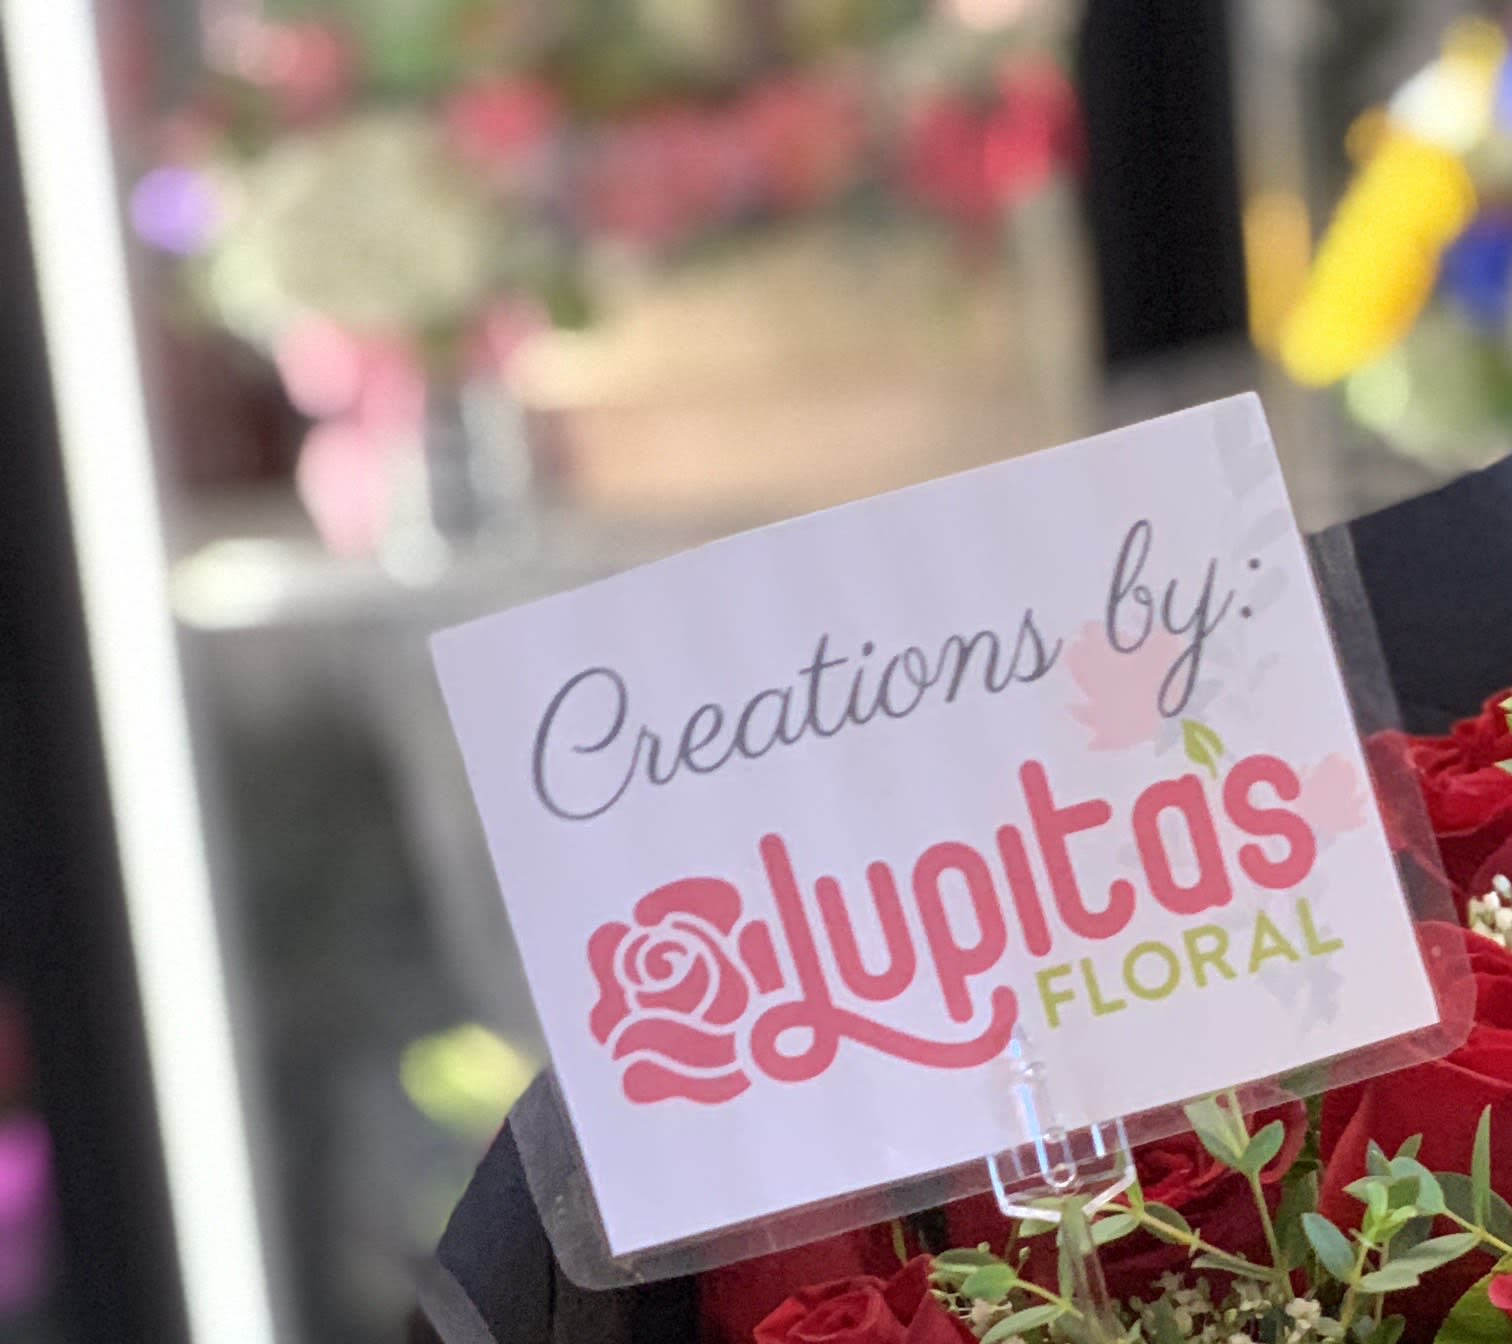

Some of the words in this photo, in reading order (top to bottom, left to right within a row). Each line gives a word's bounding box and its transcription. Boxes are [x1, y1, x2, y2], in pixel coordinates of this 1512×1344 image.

[530, 608, 1063, 821] Creations
[1105, 519, 1262, 717] by:
[1036, 900, 1344, 1028] FLORAL
